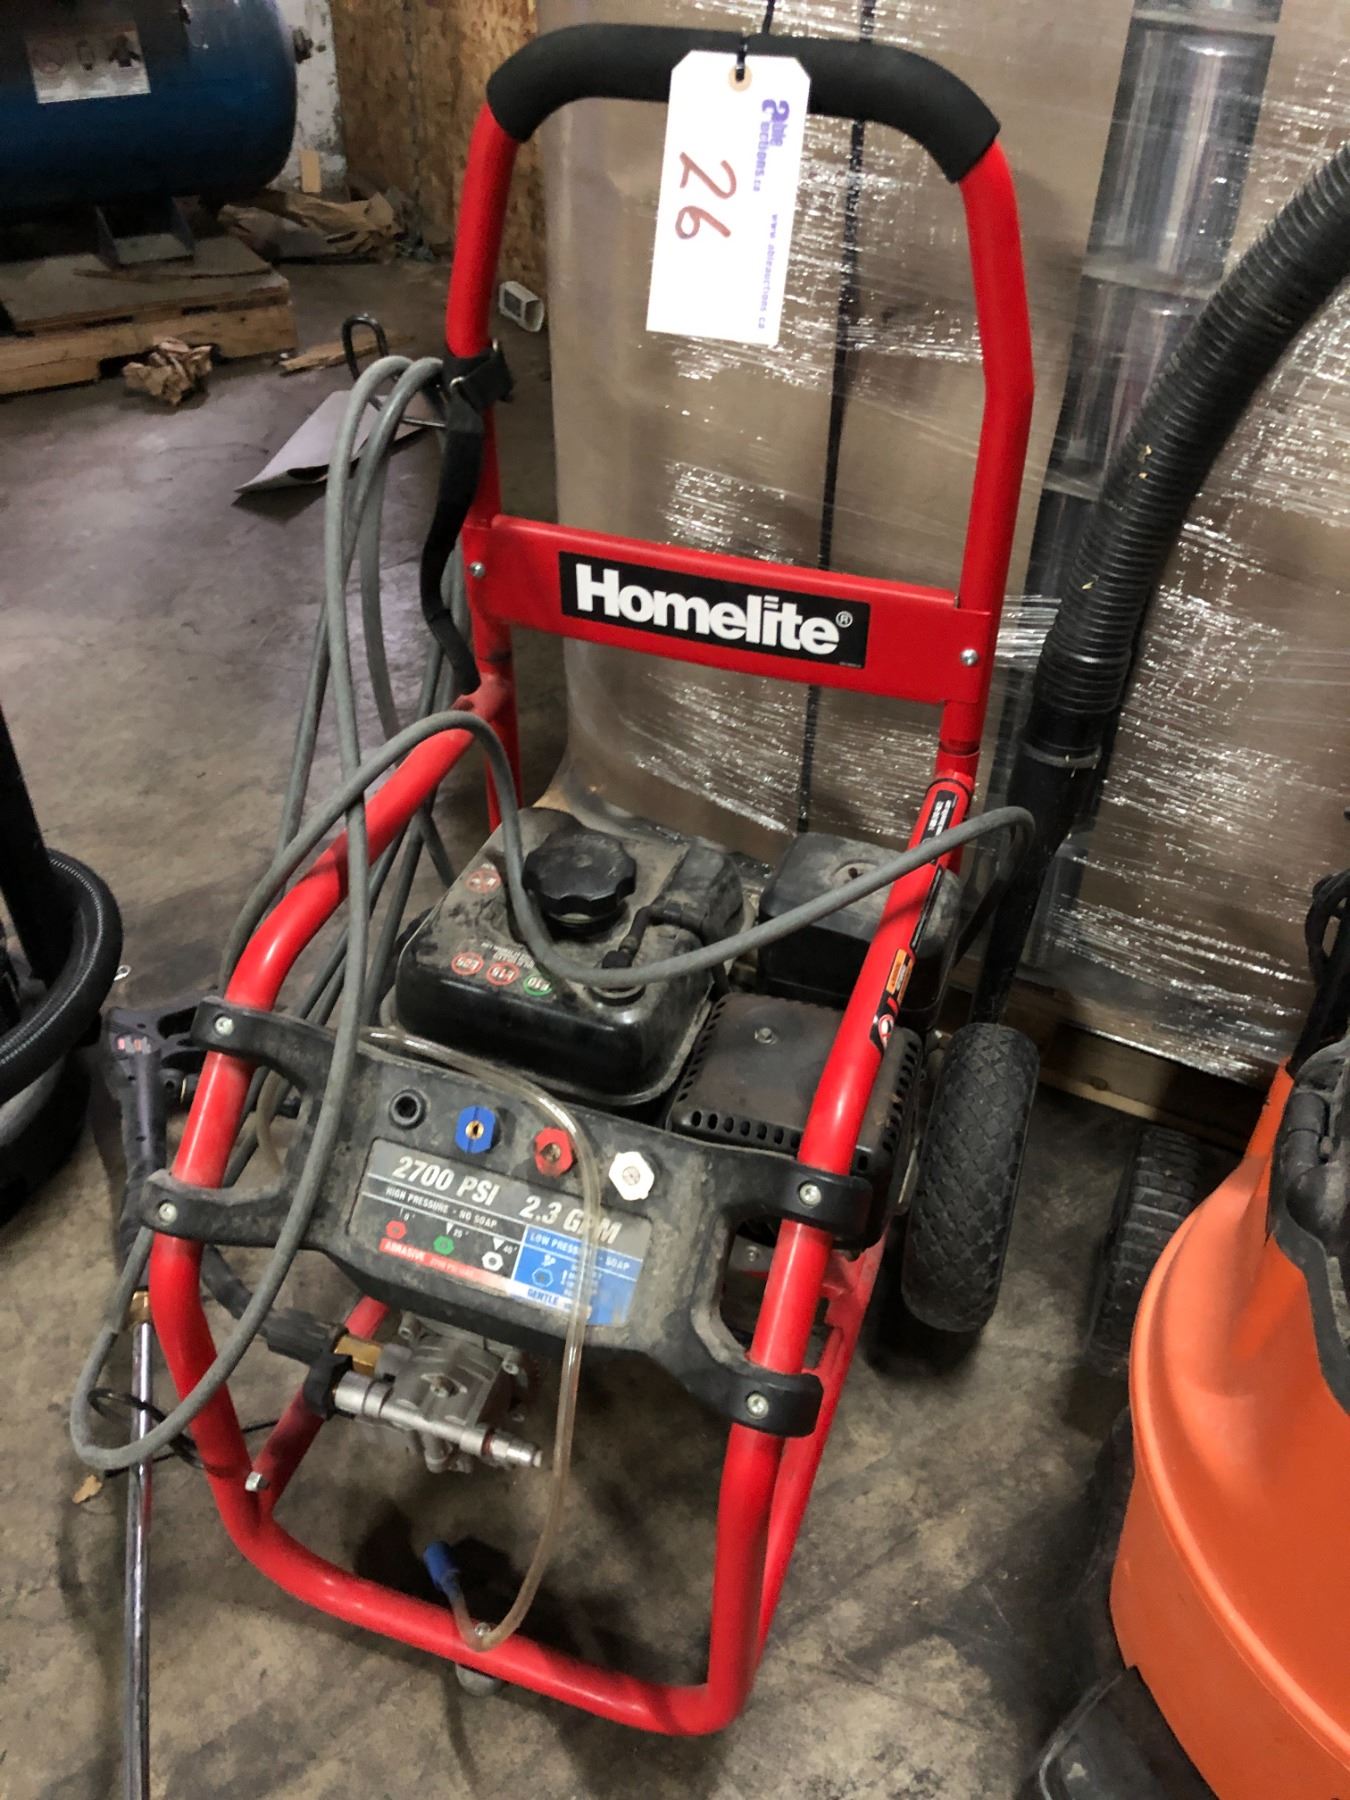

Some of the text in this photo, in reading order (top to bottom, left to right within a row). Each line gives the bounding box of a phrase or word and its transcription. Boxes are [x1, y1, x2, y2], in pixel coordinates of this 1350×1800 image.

[675, 151, 737, 240] 26
[386, 1186, 406, 1201] HIGH
[407, 1193, 449, 1214] PRESSURE
[459, 1210, 472, 1222] NO
[474, 1215, 498, 1229] SOAP
[392, 1156, 455, 1191] 2700
[456, 1175, 501, 1206] PSI
[519, 1195, 562, 1225] 2.3
[530, 1232, 550, 1248] LOW
[605, 1256, 631, 1271] SOAP
[527, 1286, 560, 1305] GENTLE
